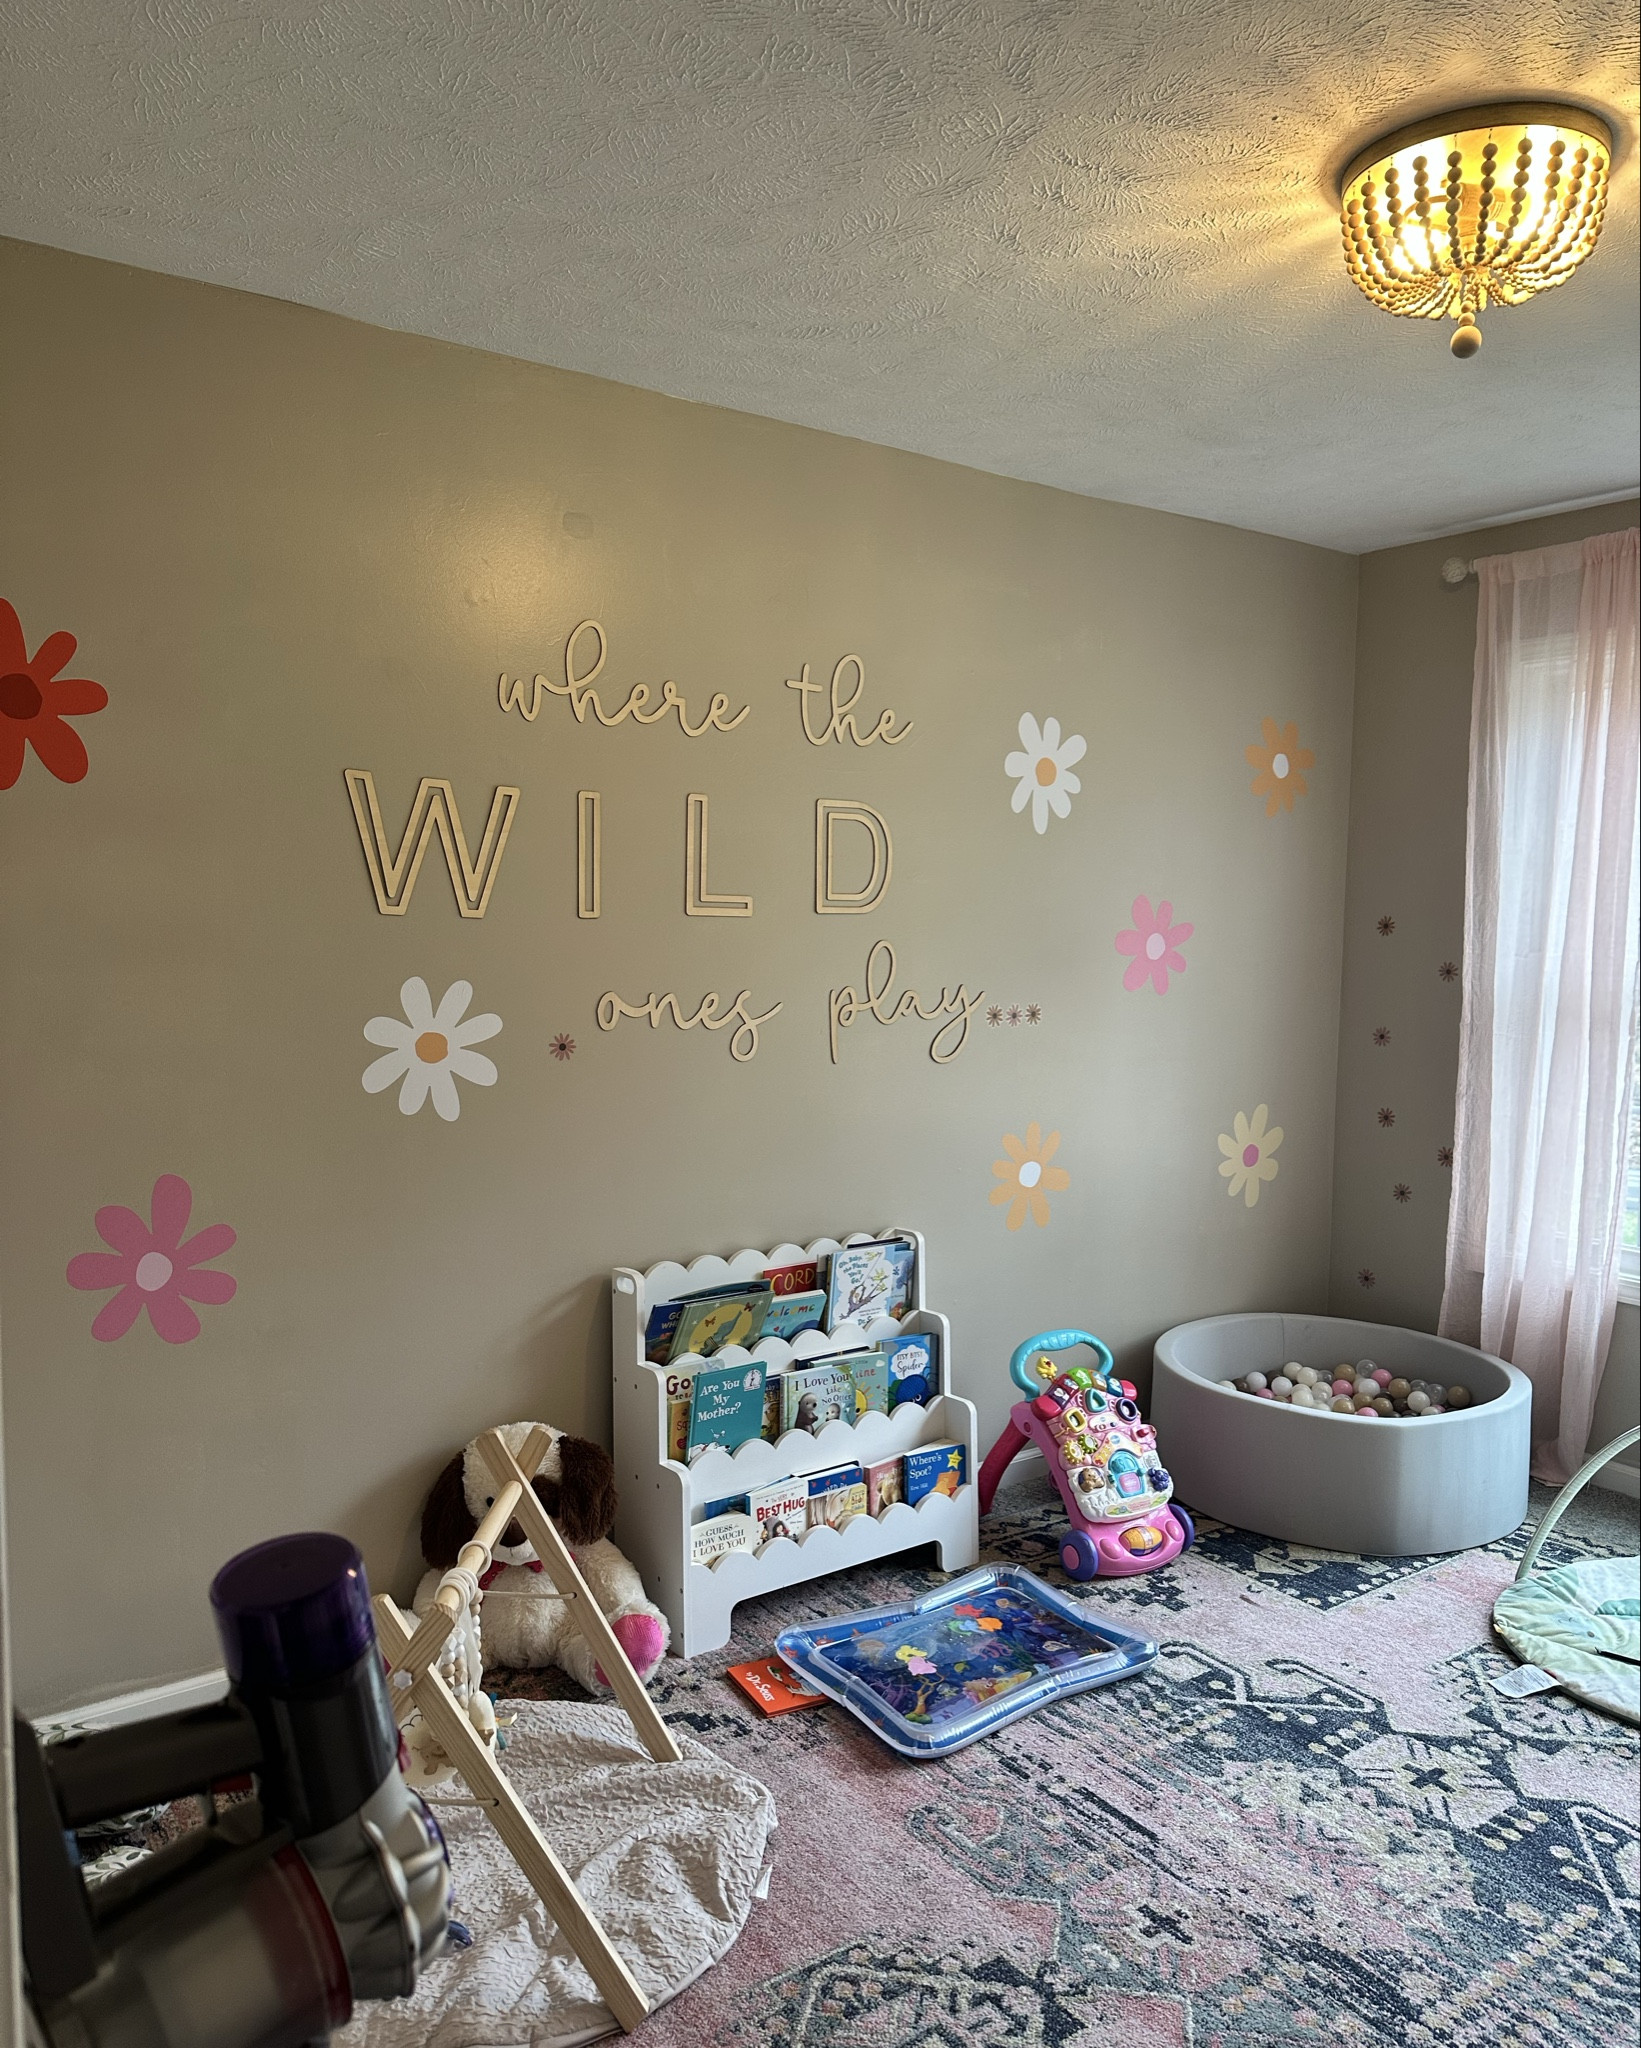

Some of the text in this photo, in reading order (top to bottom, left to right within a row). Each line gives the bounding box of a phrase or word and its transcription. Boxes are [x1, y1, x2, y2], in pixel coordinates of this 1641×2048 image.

[500, 619, 914, 747] where the
[344, 768, 894, 919] WILD
[597, 989, 784, 1063] ones
[897, 1359, 925, 1377] Spider
[699, 1384, 719, 1397] Are
[722, 1380, 740, 1391] You
[794, 1373, 850, 1391] I Love You
[826, 1385, 842, 1395] Like
[712, 1393, 730, 1406] My
[821, 1396, 833, 1405] No
[697, 1401, 742, 1423] Mother?
[909, 1452, 943, 1467] Where's
[909, 1465, 933, 1480] Spot?
[756, 1502, 782, 1523] BEST
[783, 1496, 806, 1514] HUG
[694, 1528, 745, 1549] HOW MUCH
[705, 1524, 734, 1537] GUESS
[692, 1536, 746, 1559] I LOVE YOU
[755, 1683, 775, 1701] Seuss
